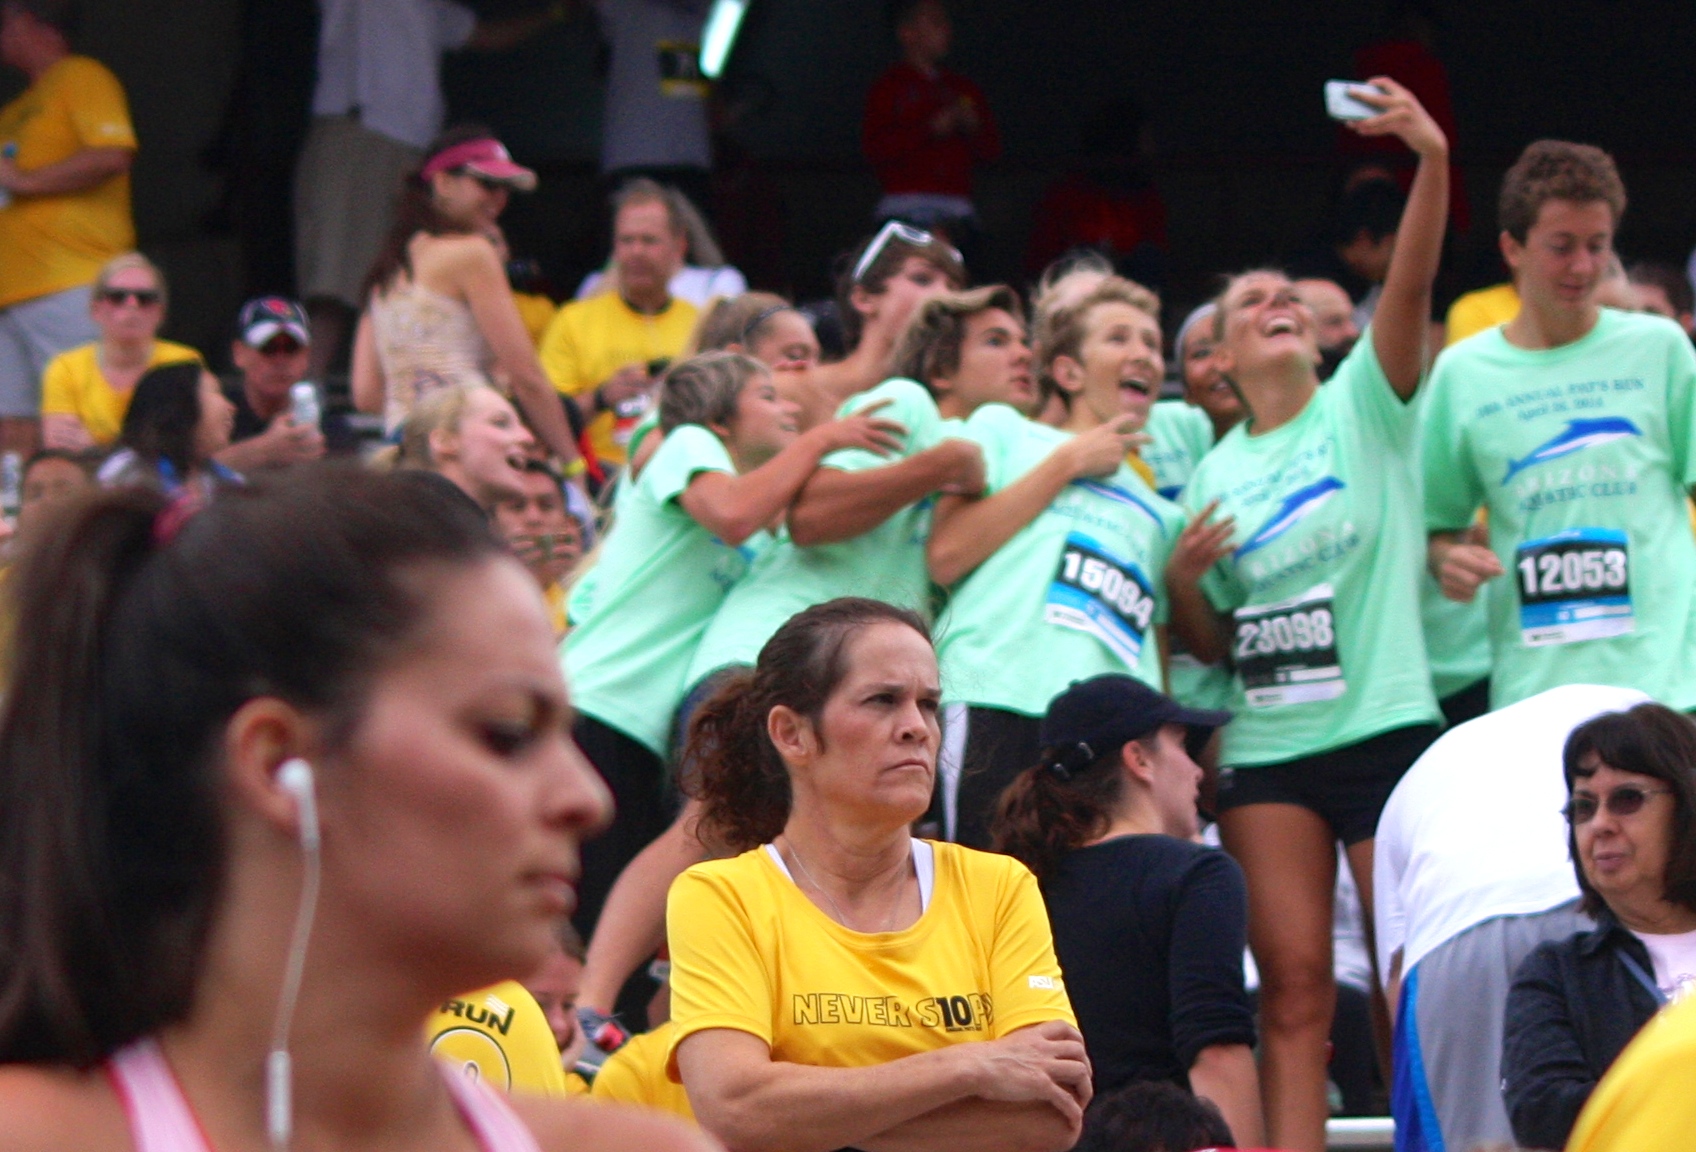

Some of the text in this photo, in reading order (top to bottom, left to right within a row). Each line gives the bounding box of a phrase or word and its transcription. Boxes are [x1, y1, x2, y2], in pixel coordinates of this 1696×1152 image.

[1519, 549, 1627, 595] 12053
[1237, 609, 1334, 657] 23098
[440, 998, 515, 1036] RUN
[793, 993, 912, 1028] NEVER
